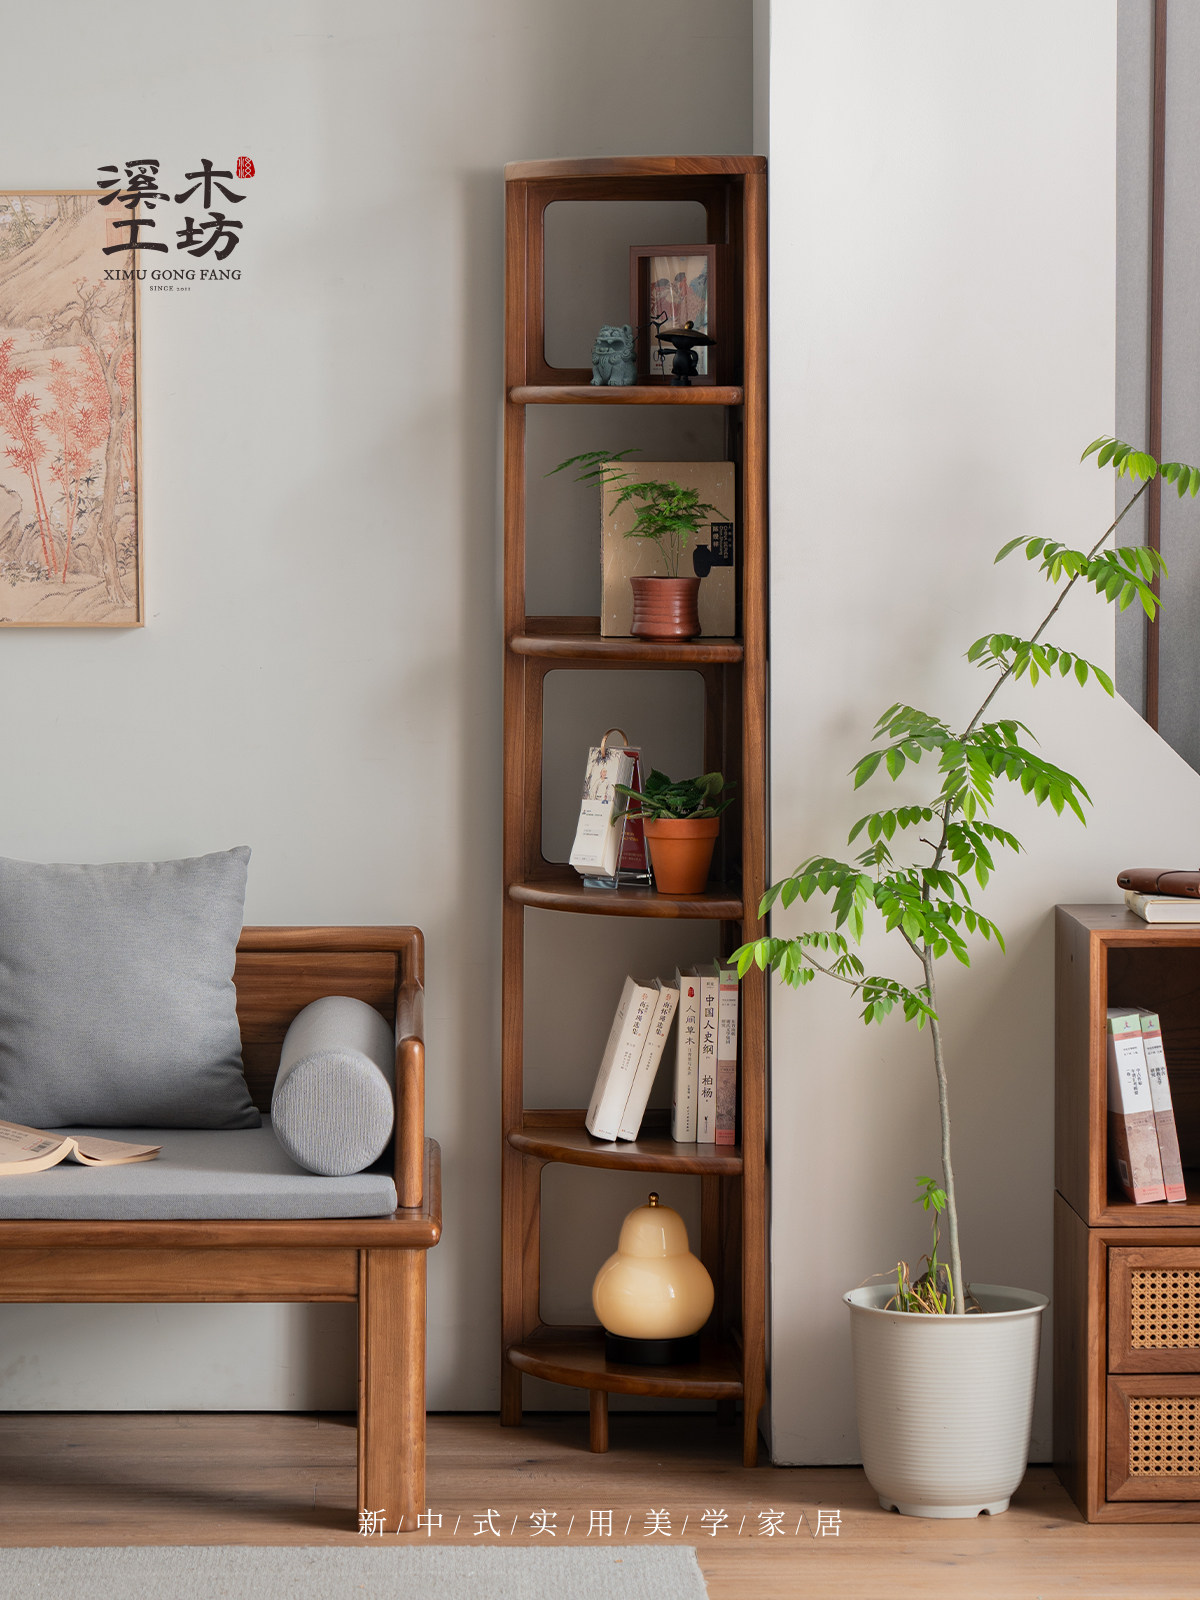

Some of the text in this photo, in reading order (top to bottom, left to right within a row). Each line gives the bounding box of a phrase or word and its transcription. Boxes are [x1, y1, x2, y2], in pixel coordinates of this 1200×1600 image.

[685, 1005, 696, 1045] 人间草木
[702, 994, 715, 1056] 中国人史纲
[701, 1074, 713, 1098] 柏杨
